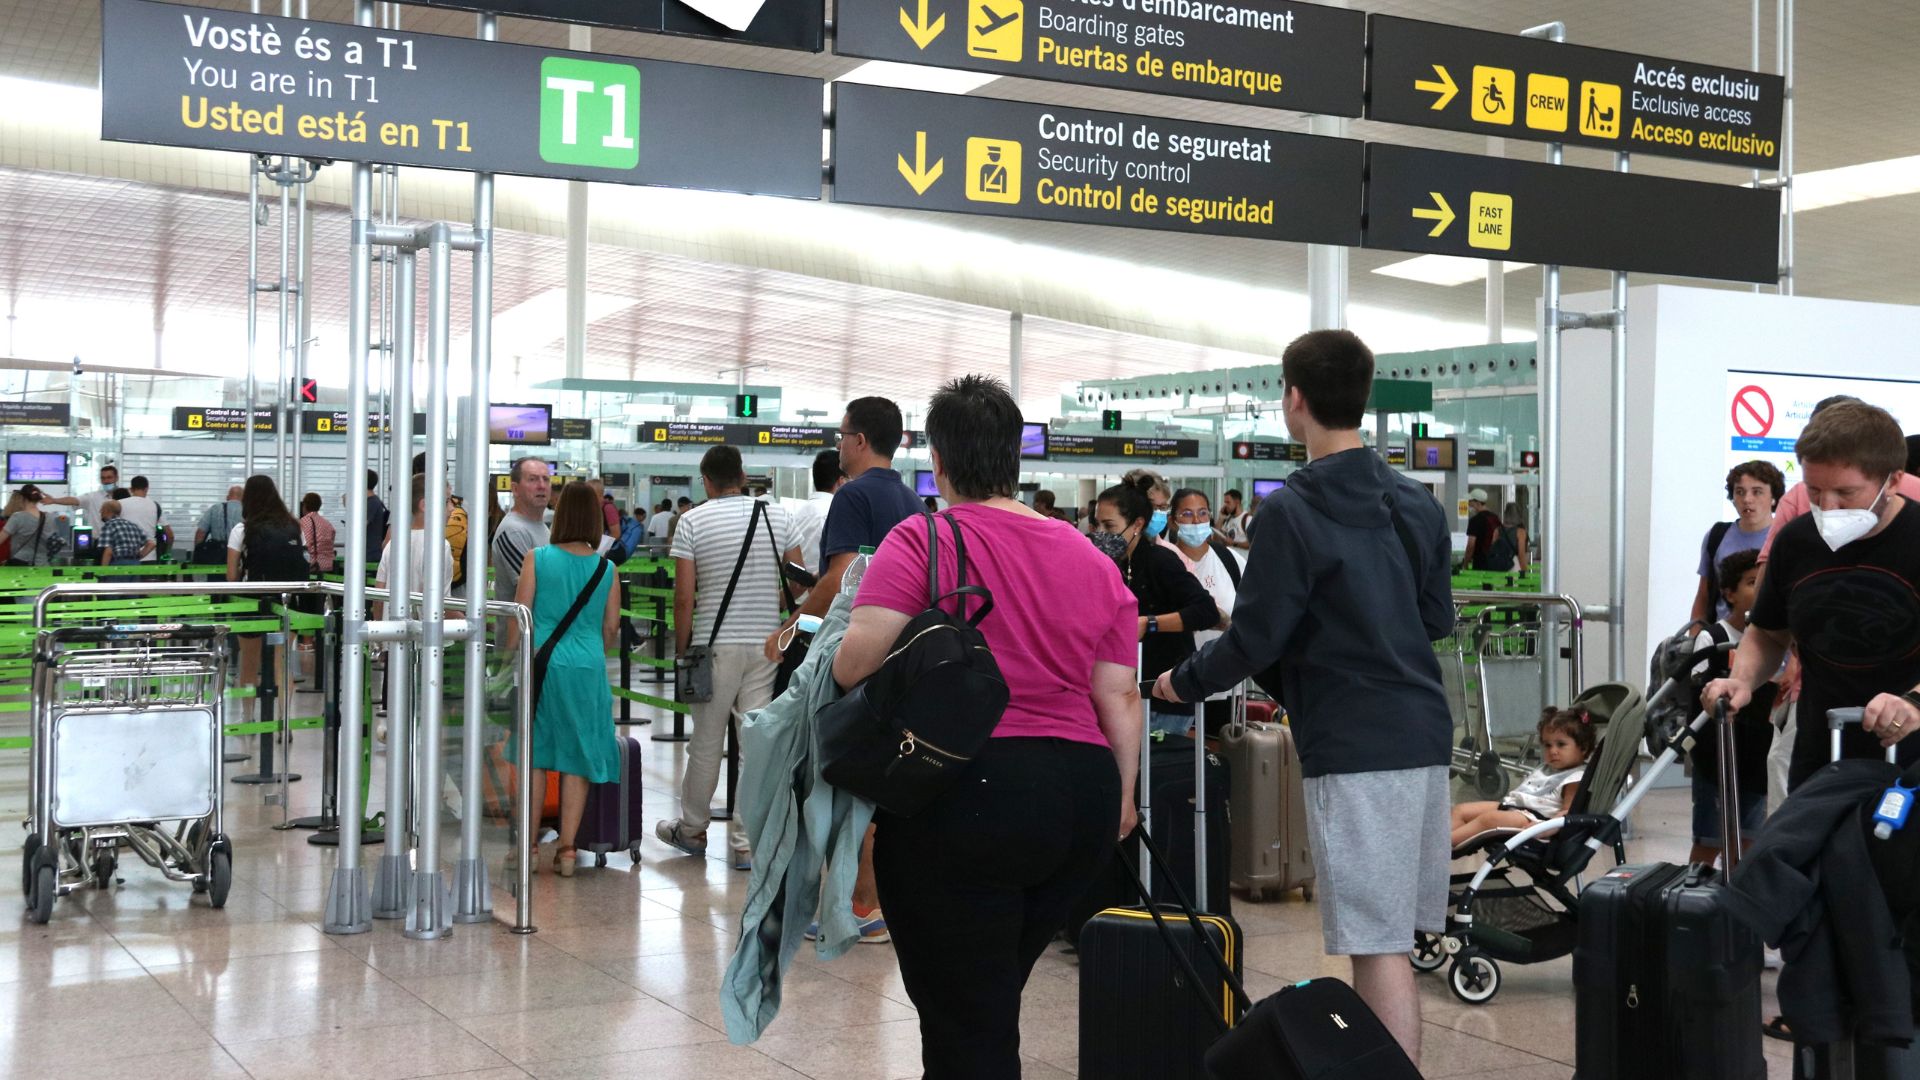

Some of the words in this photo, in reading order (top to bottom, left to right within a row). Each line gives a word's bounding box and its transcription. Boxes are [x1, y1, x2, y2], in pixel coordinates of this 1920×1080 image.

[183, 14, 282, 56] Vostè
[295, 27, 332, 62] és
[344, 42, 363, 65] a
[376, 36, 418, 71] T1
[1038, 7, 1128, 44] Boarding
[1134, 24, 1185, 47] gates
[183, 57, 237, 90] You
[250, 71, 296, 95] are
[307, 70, 333, 99] in
[344, 73, 379, 103] T1
[1038, 36, 1128, 74] Puertas
[1136, 50, 1164, 77] de
[1171, 62, 1283, 95] embarque
[1633, 62, 1686, 91] Accés
[1691, 76, 1760, 102] exclusiu
[546, 76, 634, 149] T1
[1530, 94, 1565, 112] CREW
[1632, 91, 1700, 119] Exclusive
[1704, 106, 1752, 126] access
[181, 95, 284, 136] Usted
[297, 111, 367, 144] está
[379, 122, 420, 148] en
[432, 118, 473, 153] T1
[1039, 113, 1123, 147] Control
[1132, 127, 1160, 151] de
[1168, 135, 1272, 164] seguretat
[1631, 117, 1693, 146] Acceso
[1699, 129, 1775, 158] exclusivo
[1038, 148, 1118, 179] Security
[1125, 161, 1191, 184] control
[1036, 178, 1122, 212] Control
[1129, 190, 1158, 215] de
[1166, 197, 1274, 226] seguridad
[1479, 206, 1503, 219] FAST
[1478, 222, 1503, 235] LANE
[1330, 1013, 1348, 1029] it
